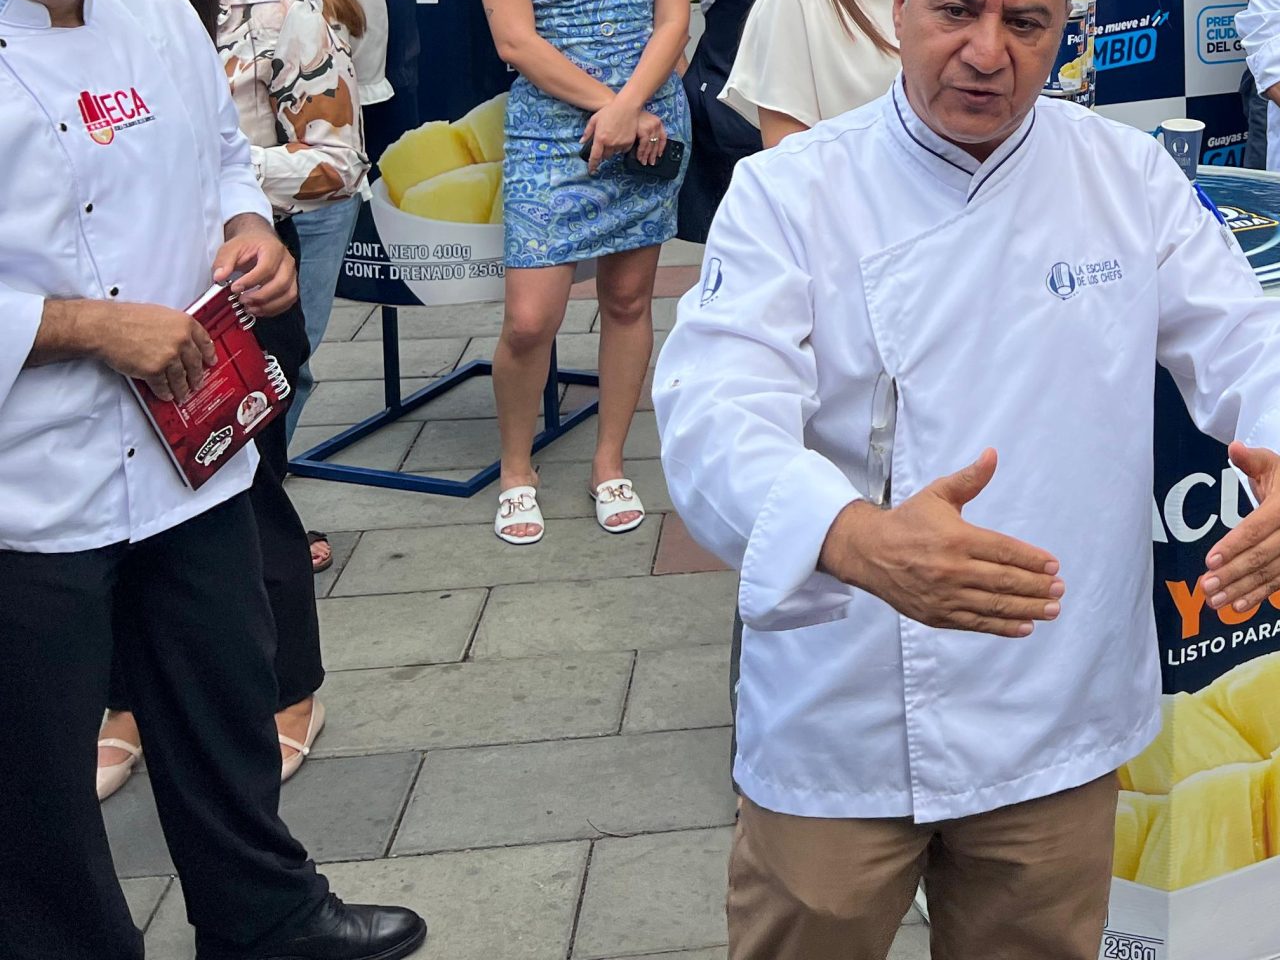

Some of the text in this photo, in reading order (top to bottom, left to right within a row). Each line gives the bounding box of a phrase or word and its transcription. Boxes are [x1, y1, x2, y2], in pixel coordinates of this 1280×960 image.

[1105, 21, 1138, 34] mueve
[1140, 15, 1150, 27] al
[1094, 33, 1150, 67] MBIO
[1207, 41, 1230, 54] DEL
[1207, 132, 1242, 146] Guayas
[389, 244, 429, 259] NETO
[433, 244, 471, 261] 400g
[345, 262, 506, 281] CONT. DRENADO 256g
[1075, 259, 1120, 276] LA ESCUELA
[1077, 269, 1122, 287] DE LOS CHEFS
[1168, 636, 1226, 666] LISTO
